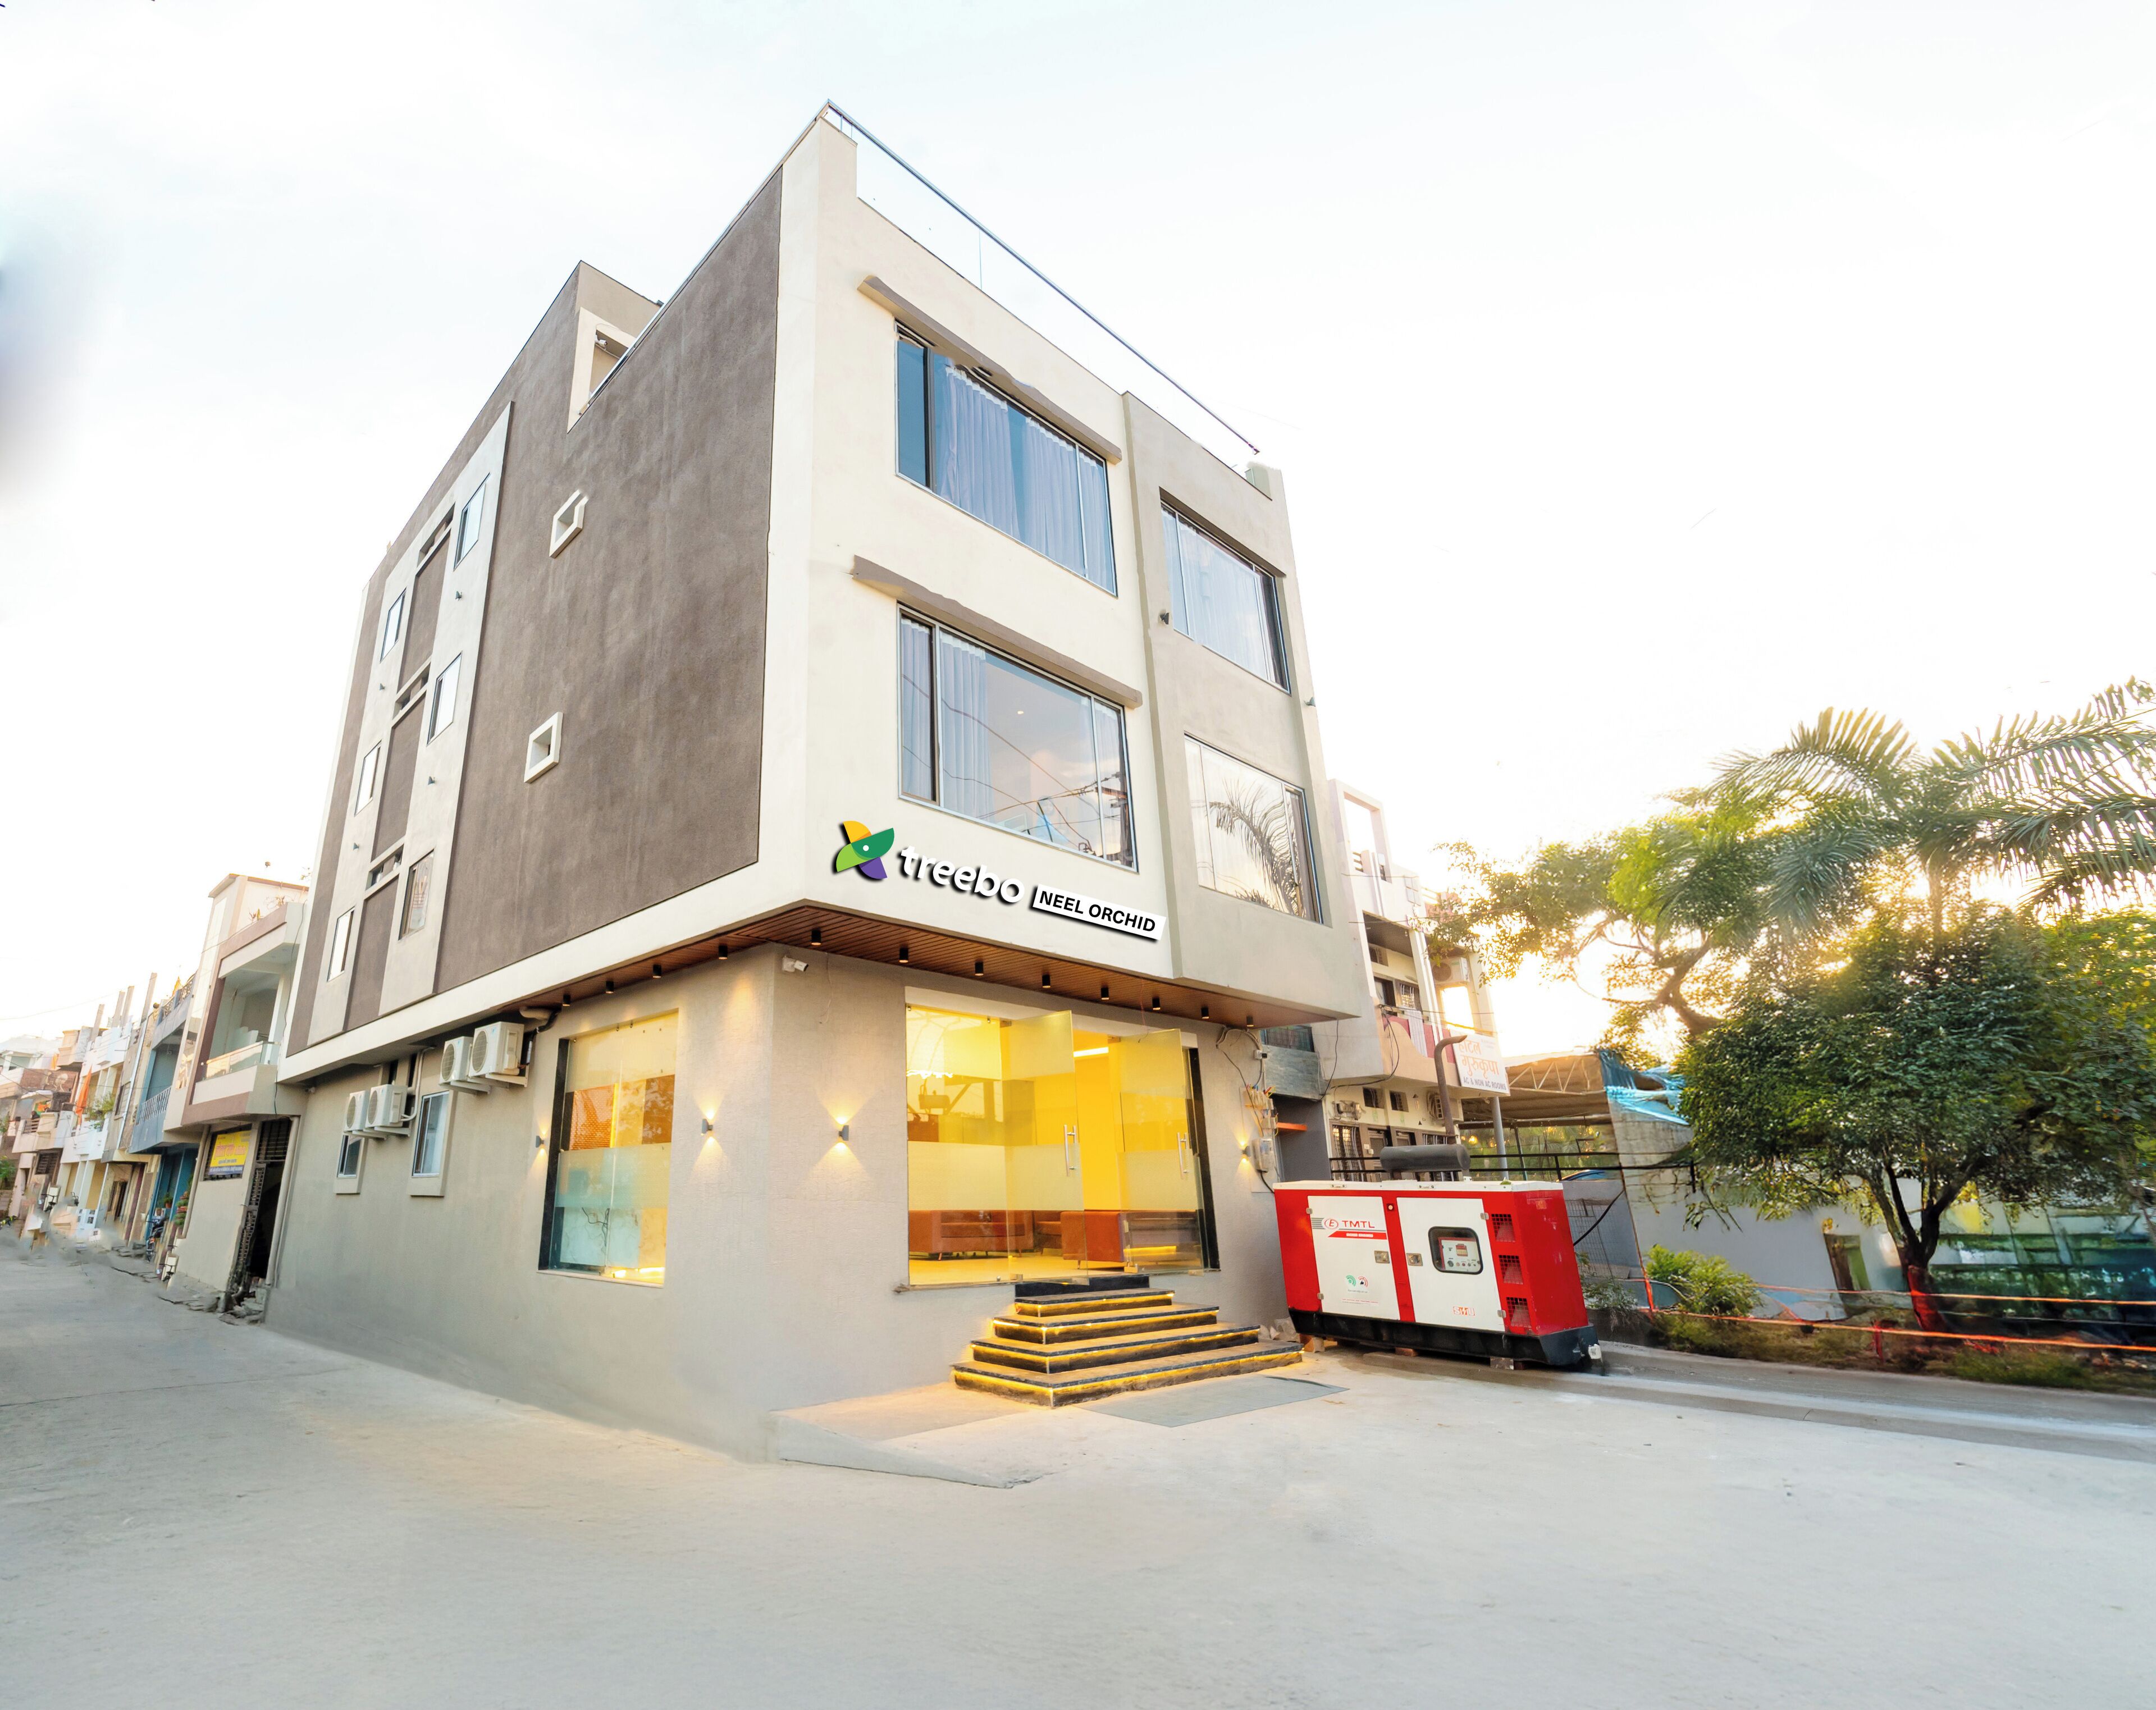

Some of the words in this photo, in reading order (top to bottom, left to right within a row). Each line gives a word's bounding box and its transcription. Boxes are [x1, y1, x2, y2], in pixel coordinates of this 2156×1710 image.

[901, 845, 1025, 903] treebo
[1039, 890, 1084, 914] NEEL
[1089, 904, 1155, 932] ORCHID
[1463, 1076, 1469, 1085] AC
[1474, 1078, 1484, 1087] NON
[1491, 1081, 1506, 1090] ROOMS
[1342, 1220, 1375, 1228] TMTL
